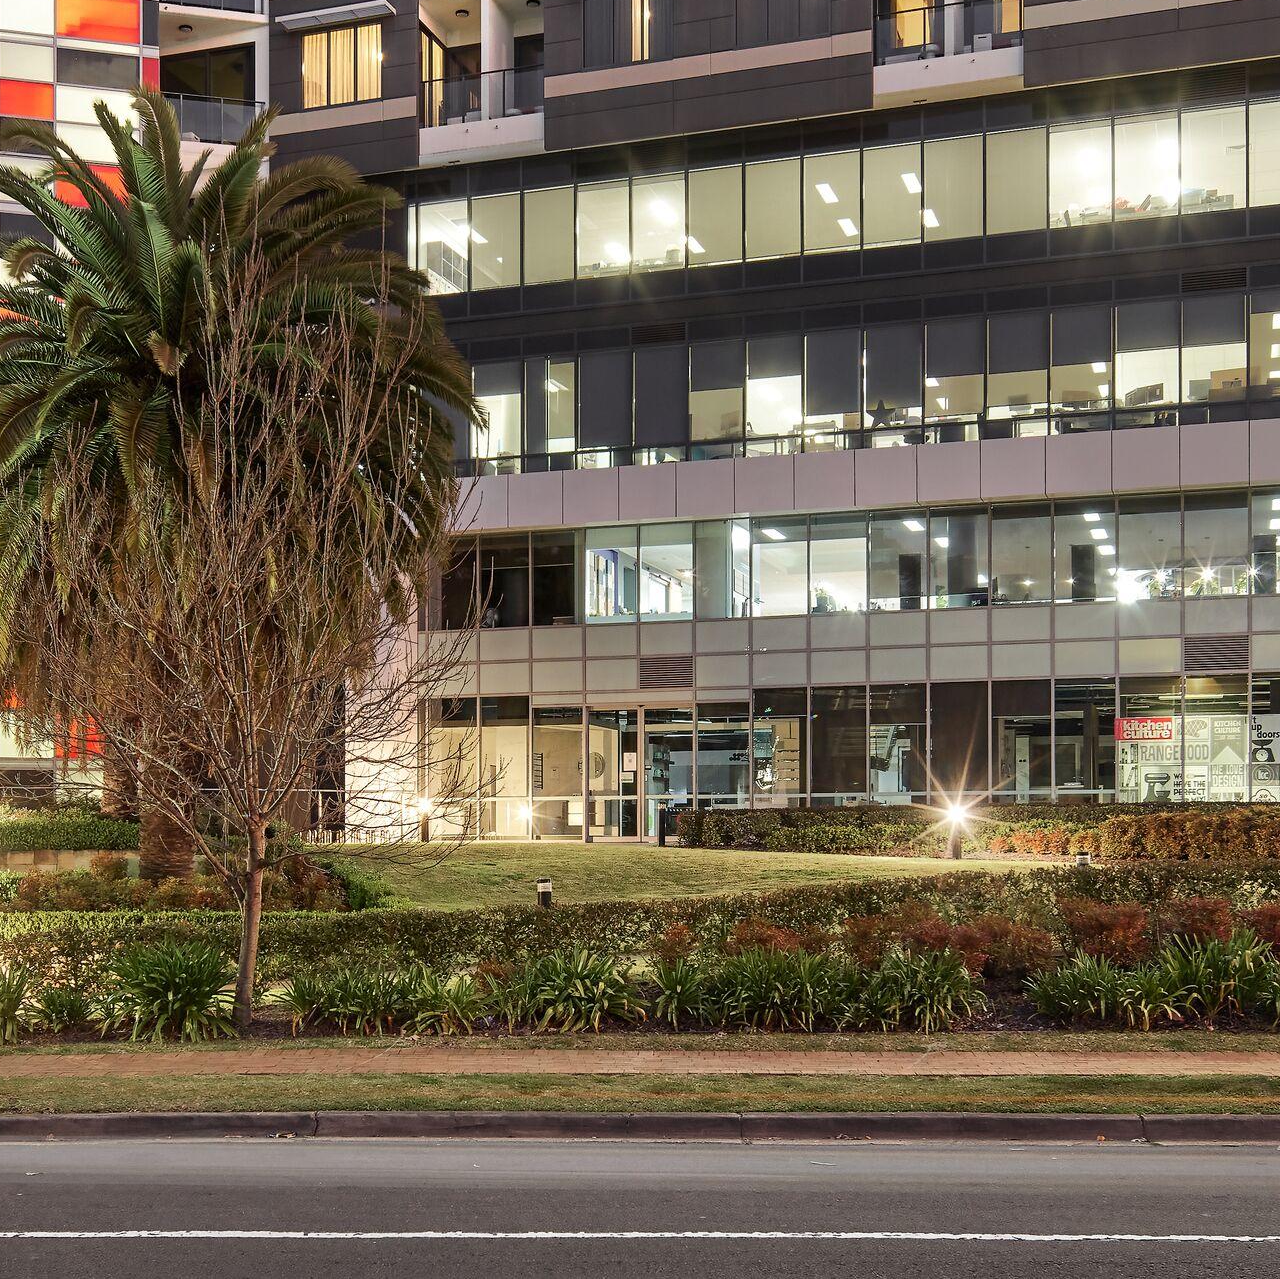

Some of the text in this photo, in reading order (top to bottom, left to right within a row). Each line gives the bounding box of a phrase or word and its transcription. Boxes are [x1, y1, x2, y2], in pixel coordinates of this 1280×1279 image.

[1123, 719, 1172, 731] kitchen
[1251, 724, 1263, 732] up
[1123, 730, 1171, 739] culture
[1256, 731, 1280, 739] doors
[1140, 744, 1209, 761] RANGEOOD
